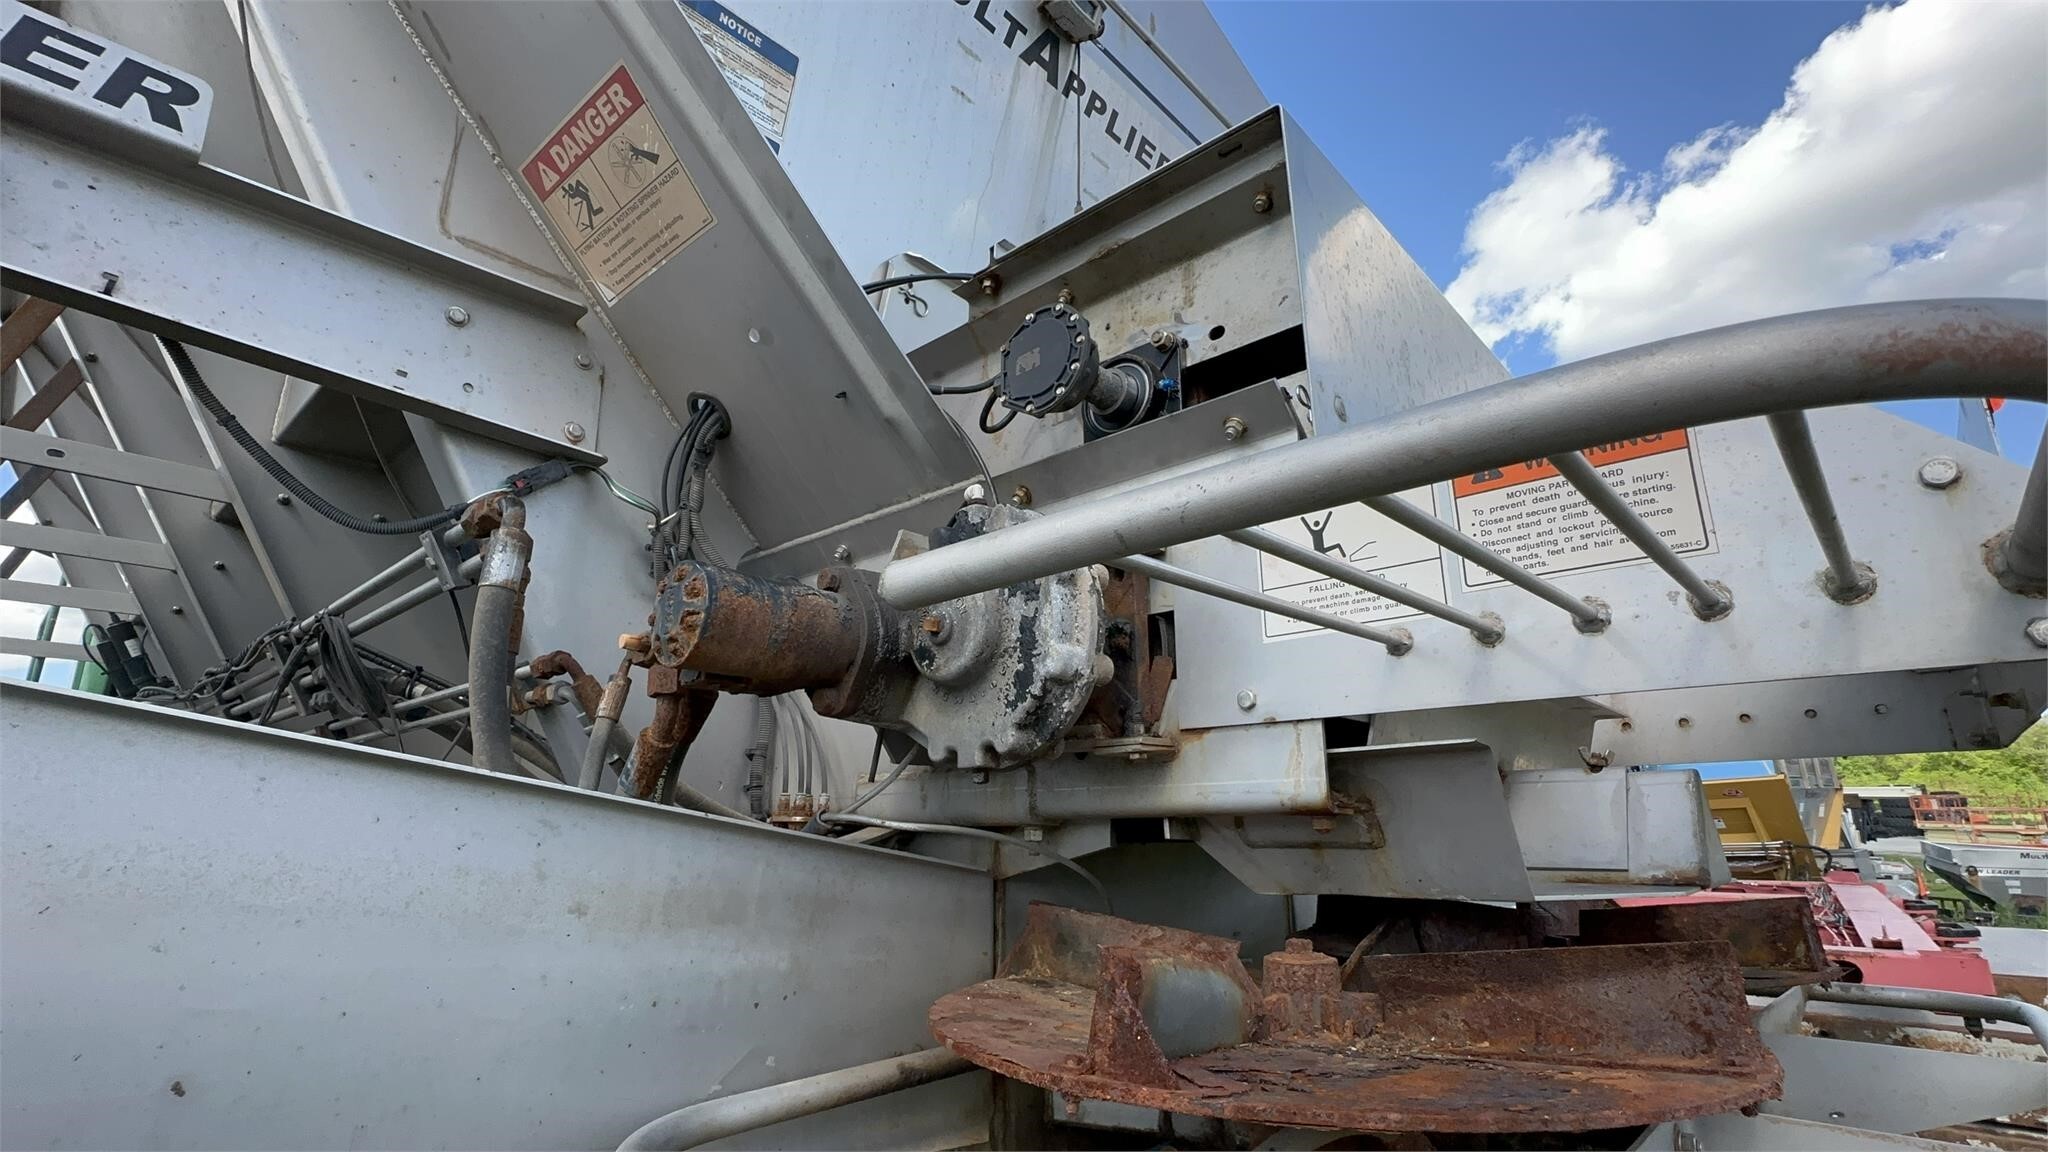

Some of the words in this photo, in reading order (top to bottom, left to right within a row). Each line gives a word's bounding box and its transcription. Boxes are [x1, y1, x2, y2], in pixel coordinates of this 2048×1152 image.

[719, 12, 762, 48] NOTICE
[0, 14, 200, 133] ER
[953, 0, 1171, 170] LTAPPLIE
[549, 82, 632, 171] DANGER
[592, 224, 614, 245] MATERIAL
[615, 202, 639, 224] ROTATING
[637, 185, 659, 206] SPINNER
[657, 167, 679, 188] HAZARD
[1472, 508, 1484, 518] To
[1489, 499, 1526, 516] prevent
[1531, 491, 1561, 505] death
[1566, 488, 1577, 497] or
[1632, 469, 1670, 485] injury:
[1506, 484, 1546, 500] MOVING
[1548, 480, 1569, 493] PAR
[1601, 467, 1624, 480] ARD
[1478, 517, 1504, 528] Close
[1506, 510, 1523, 522] and
[1525, 505, 1558, 518] secure
[1632, 481, 1677, 498] starting.
[1480, 528, 1493, 538] Do
[1497, 523, 1512, 534] not
[1516, 517, 1542, 531] stand
[1546, 515, 1557, 524] or
[1562, 509, 1589, 521] climb
[1482, 532, 1532, 547] Disconnect
[1536, 527, 1554, 539] and
[1558, 520, 1596, 536] lockout
[1516, 538, 1559, 552] adjusting
[1563, 536, 1574, 545] or
[1579, 526, 1622, 541] servicin
[1547, 548, 1566, 557] feet
[1570, 542, 1589, 553] and
[1594, 539, 1614, 549] hair
[1655, 528, 1677, 538] rom
[1301, 595, 1328, 606] prevent
[1308, 581, 1346, 594] FALLING
[1319, 599, 1350, 610] machine
[1349, 606, 1371, 616] climb
[1372, 604, 1383, 612] on
